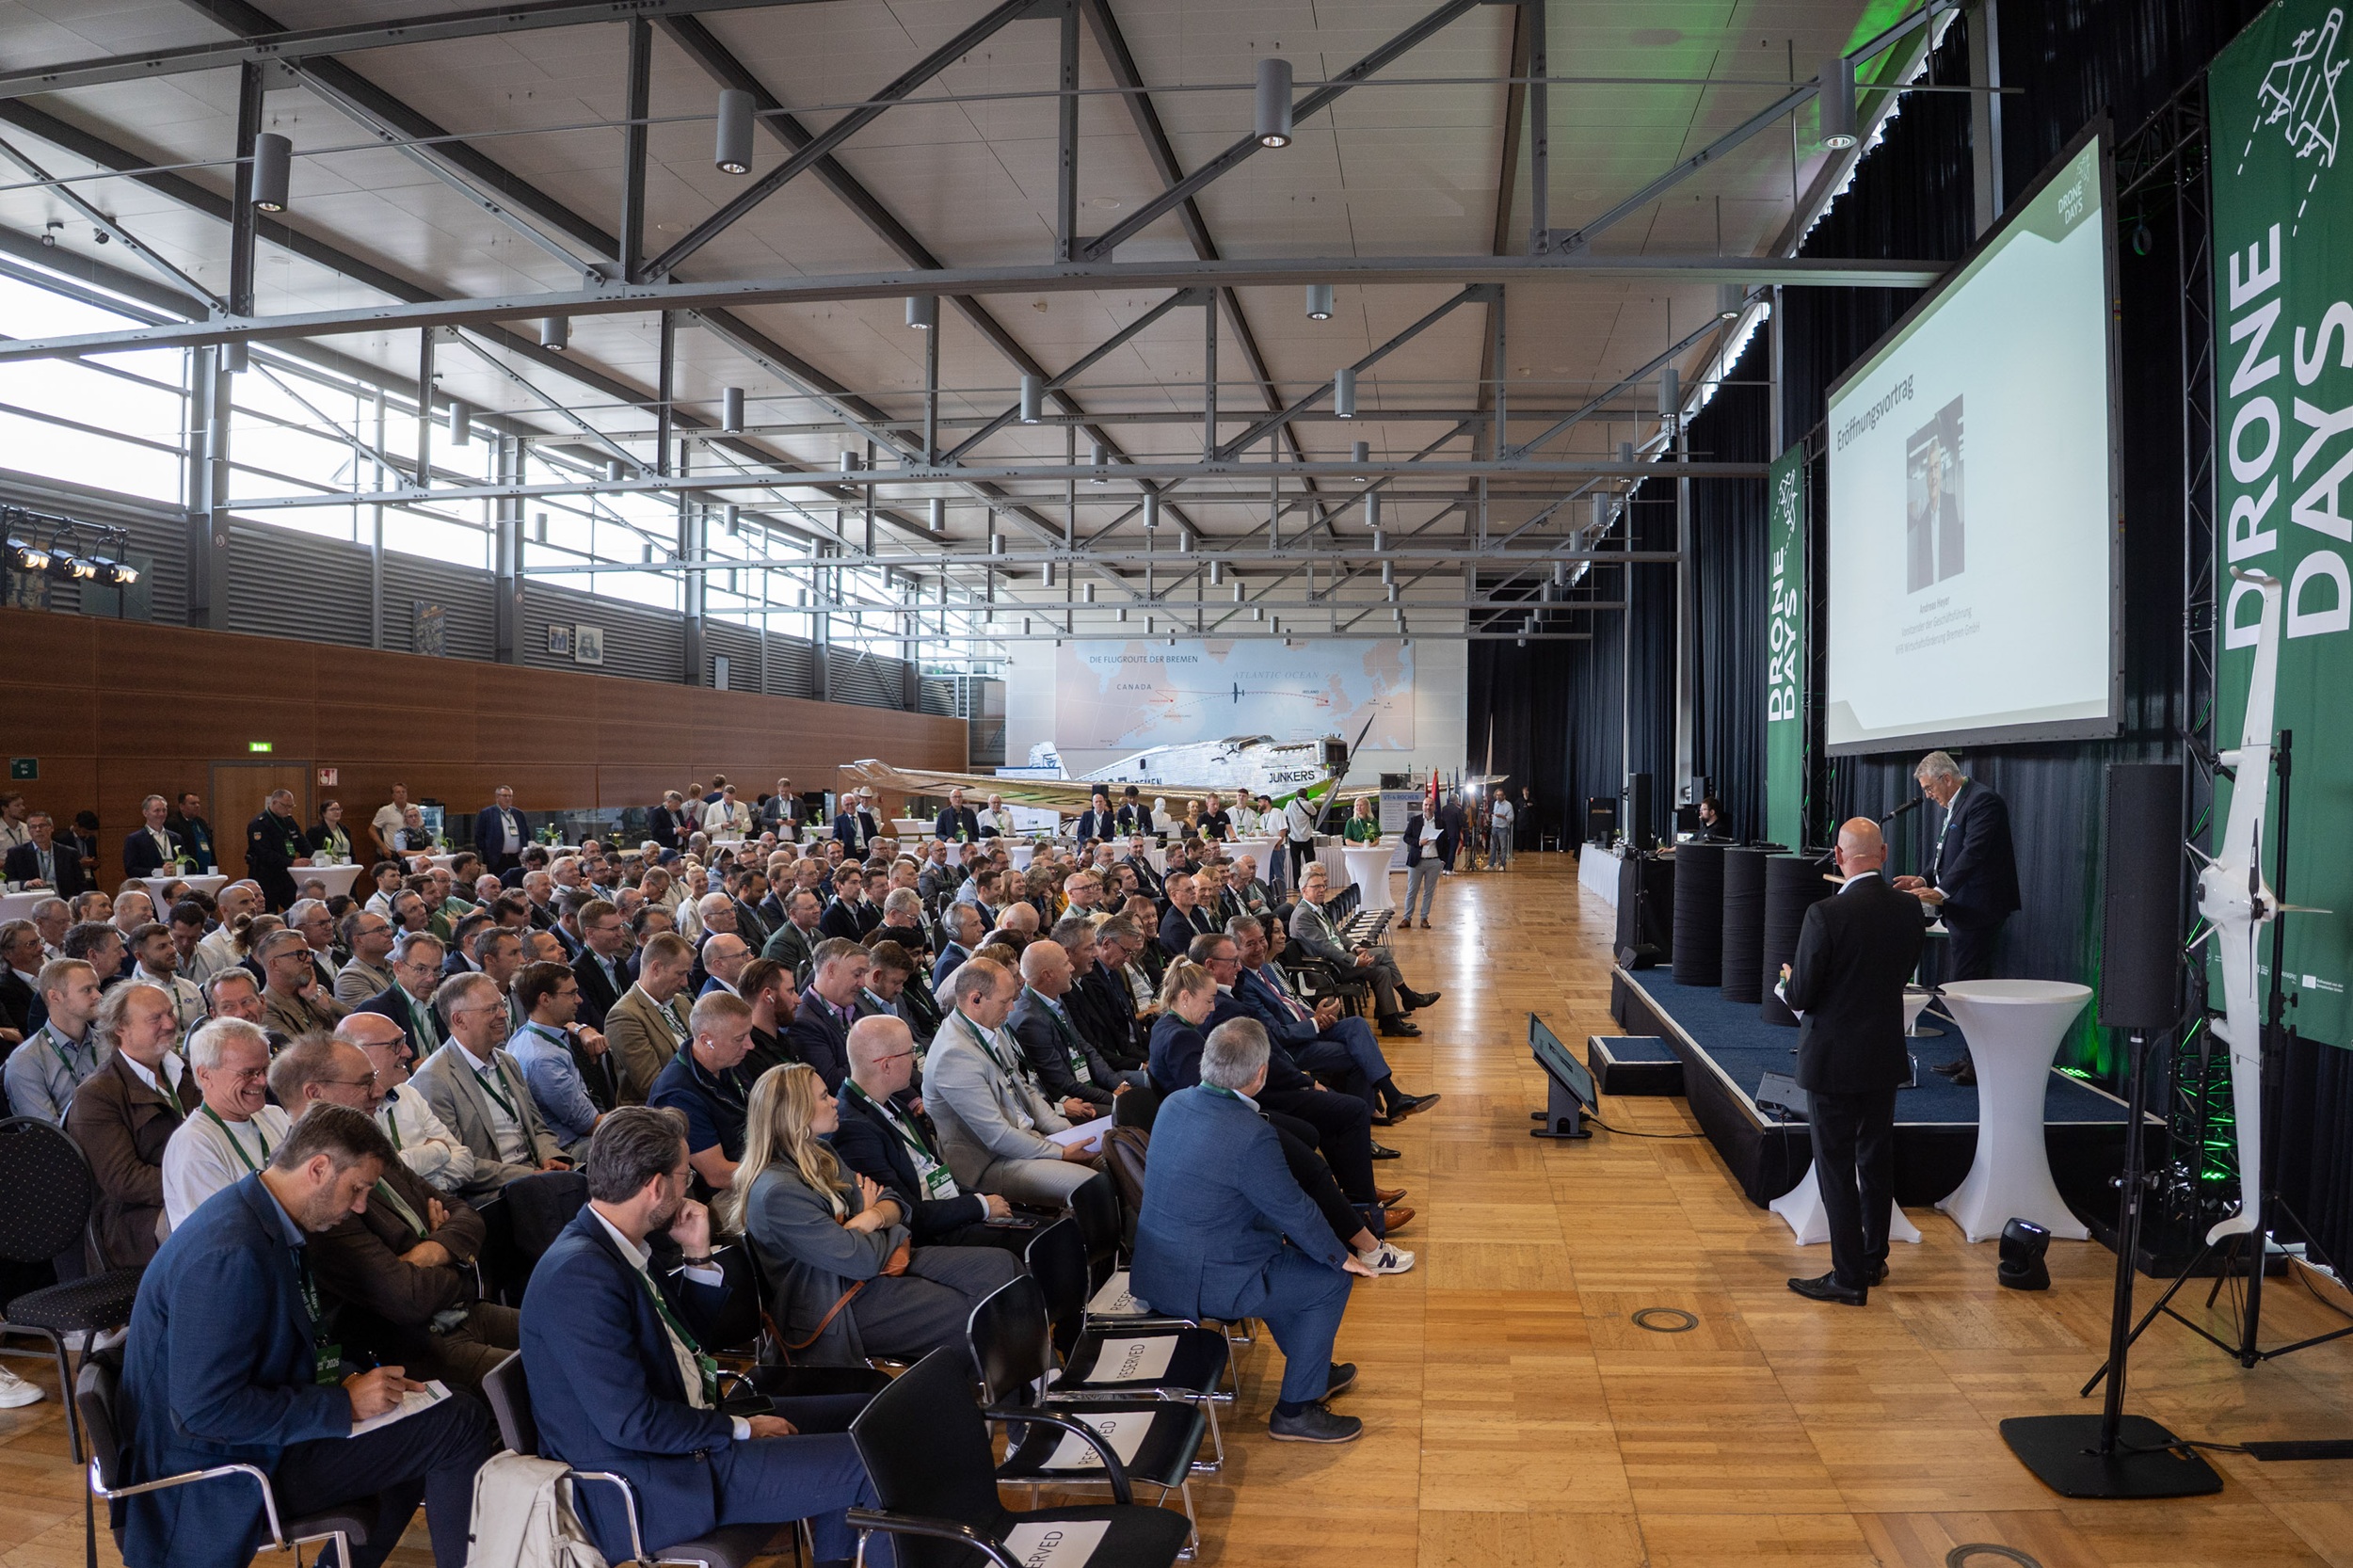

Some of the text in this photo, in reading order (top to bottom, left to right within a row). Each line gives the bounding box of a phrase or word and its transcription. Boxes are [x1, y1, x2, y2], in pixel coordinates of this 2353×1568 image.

[2058, 180, 2082, 215] DRONE
[2064, 197, 2083, 225] DAYS
[1837, 374, 1913, 452] Eröffnungsvortrag
[2225, 222, 2281, 649] DRONE
[2286, 301, 2353, 639] DAYS
[1768, 547, 1785, 722] DRONE
[1783, 587, 1797, 721] DAYS
[1233, 671, 1320, 680] ATLANTIC OCEAN
[1269, 770, 1315, 784] JUNKERS
